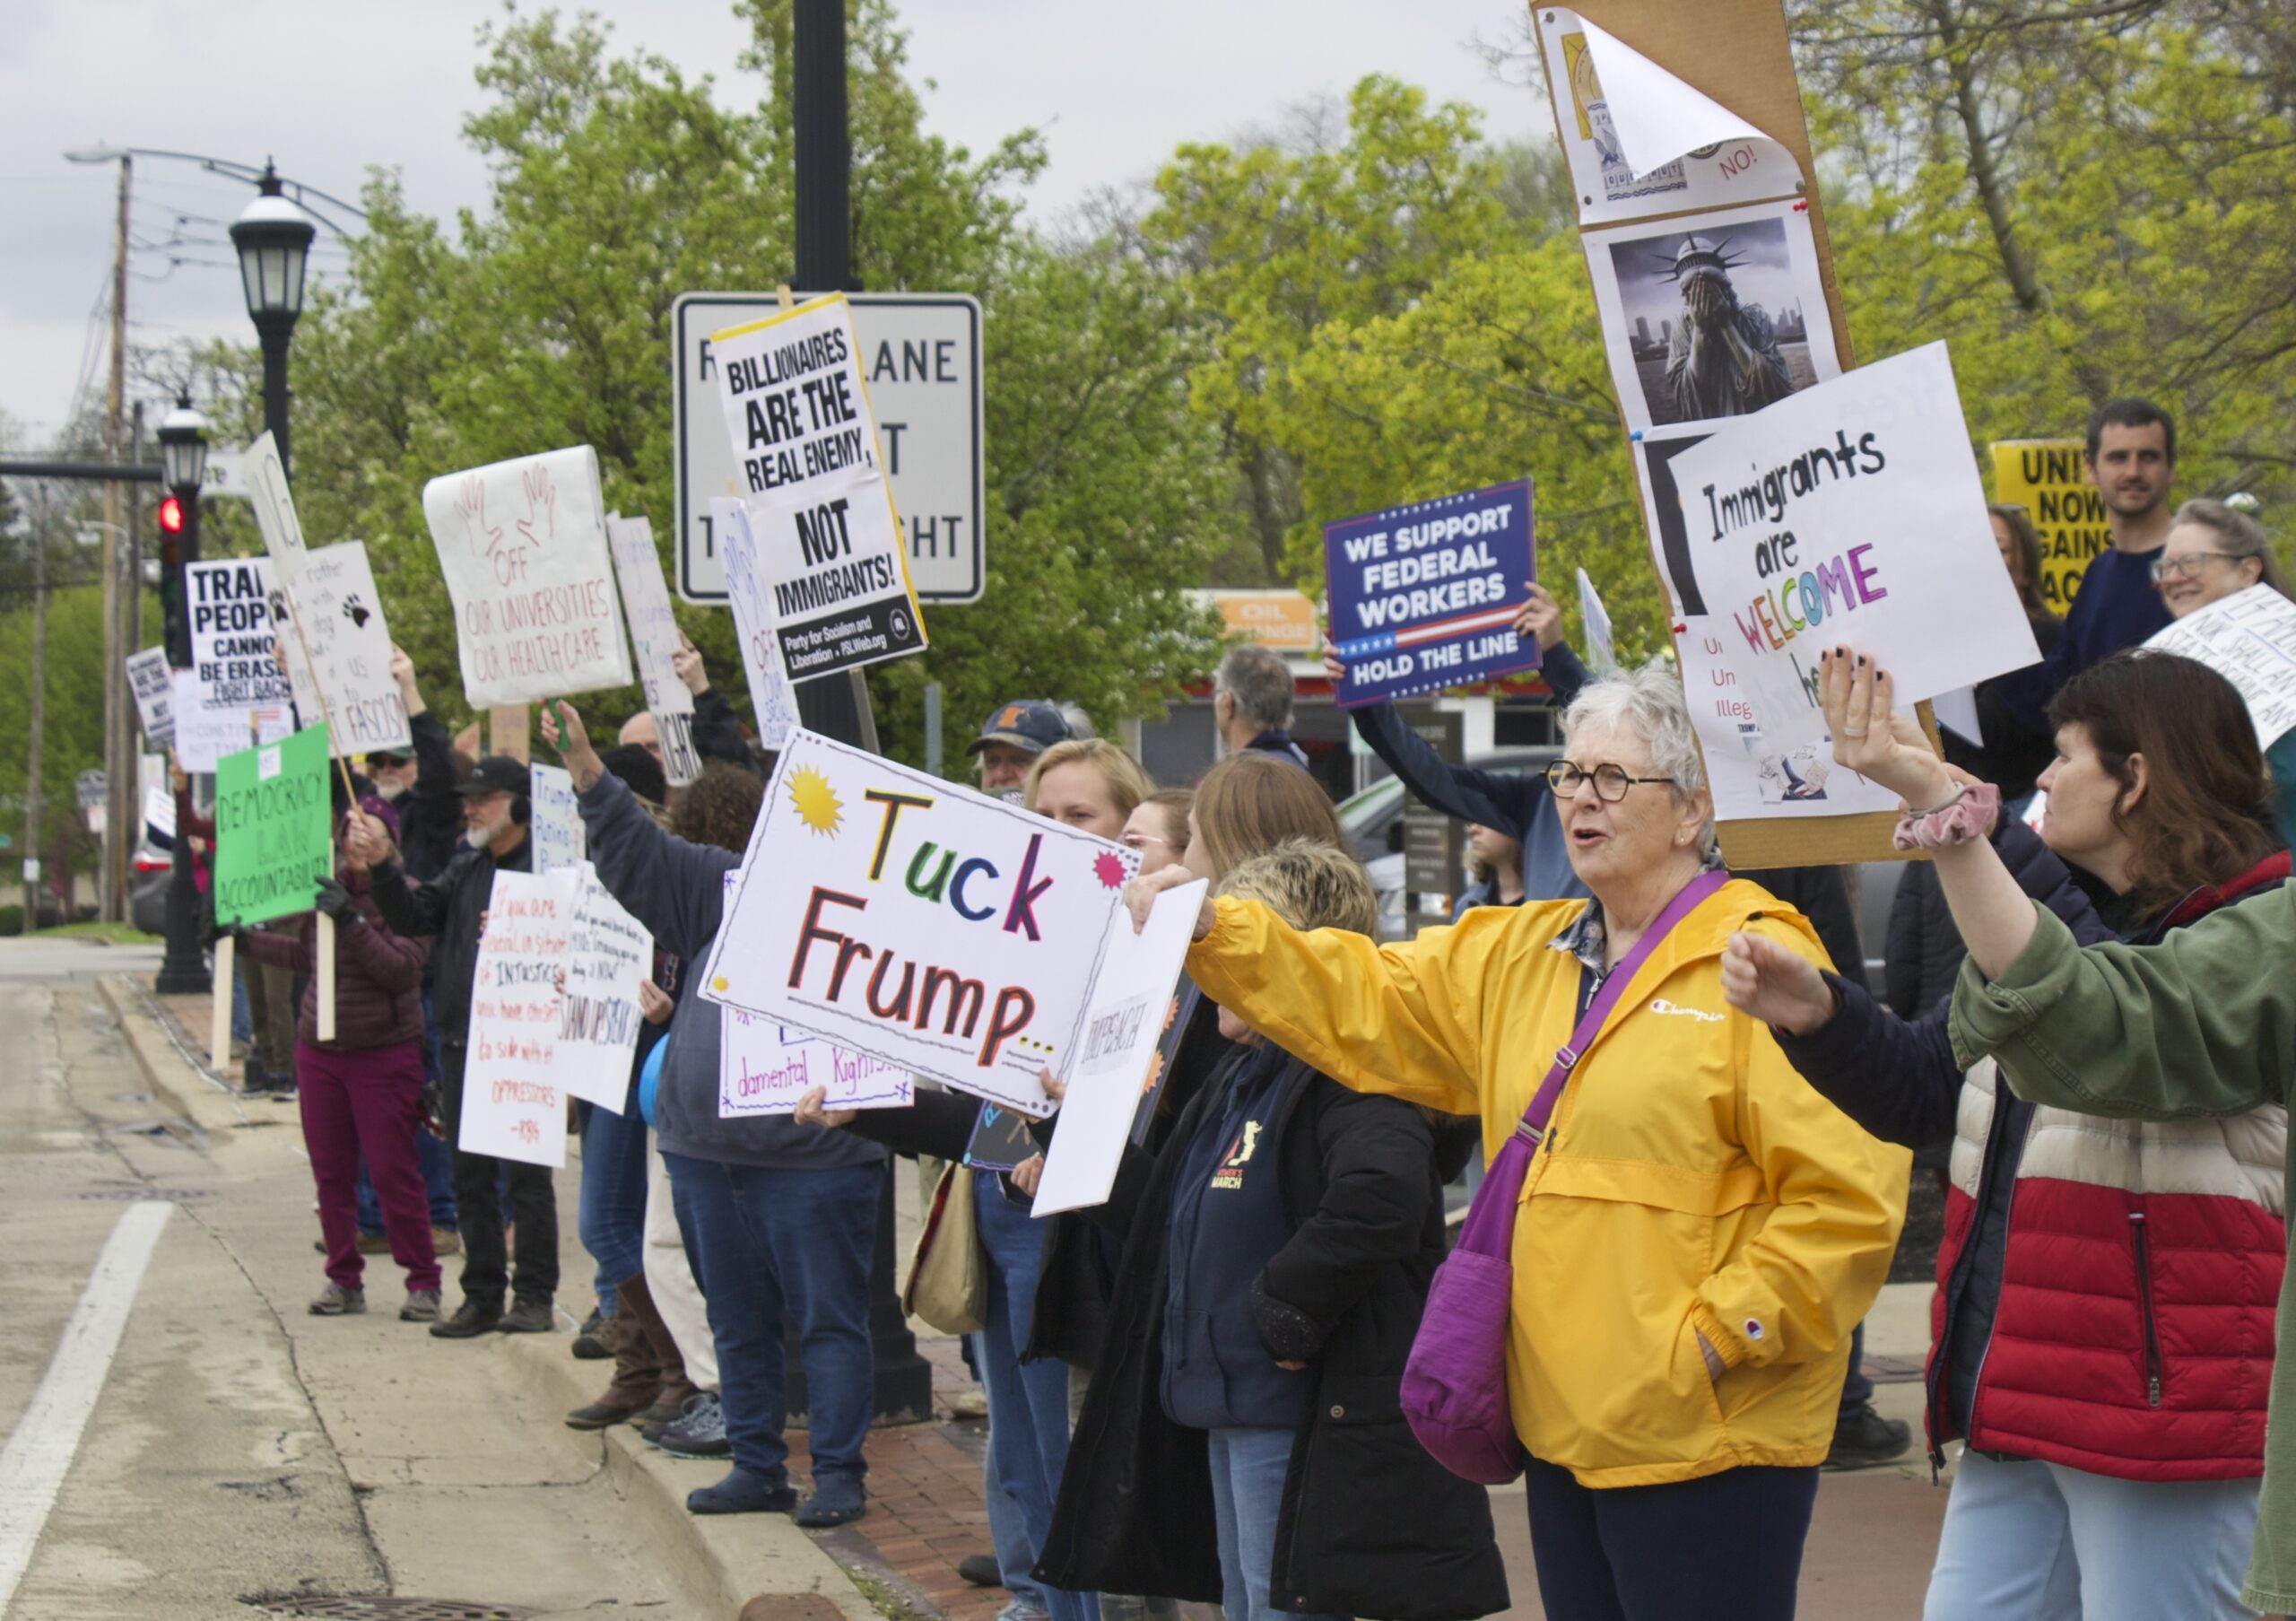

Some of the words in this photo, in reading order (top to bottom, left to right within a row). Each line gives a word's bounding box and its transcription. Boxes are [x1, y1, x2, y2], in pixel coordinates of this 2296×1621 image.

[1719, 144, 1758, 180] NO!
[726, 327, 848, 395] BILLIONAIRES
[865, 339, 958, 383] ANE
[745, 385, 804, 450] ARE
[803, 370, 857, 432] THE
[744, 452, 804, 492] REAL
[806, 426, 873, 476] ENEMY,
[2022, 449, 2087, 484] UNI
[1701, 429, 1886, 542] Immigrants
[2039, 491, 2108, 523] NOW
[795, 498, 851, 567] NOT
[1345, 533, 1388, 563] WE
[1394, 504, 1513, 554] SUPPORT
[1755, 529, 1799, 579] are
[192, 564, 265, 602] TRA
[494, 545, 528, 588] OFF
[774, 553, 896, 617] IMMIGRANTS!
[1362, 541, 1498, 595] FEDERAL
[195, 601, 274, 633] PEOP
[499, 578, 610, 632] UNIVERSITIES
[1240, 602, 1285, 622] OIL
[1356, 572, 1507, 629] WORKERS
[1734, 542, 1888, 656] WELCOME
[213, 635, 276, 658] CANNO
[785, 634, 809, 652] Party
[809, 630, 822, 645] for
[822, 621, 856, 641] Socialism
[856, 614, 873, 632] and
[789, 649, 834, 670] Liberation
[839, 633, 888, 657] PSLWeb.org
[199, 661, 223, 682] BE
[228, 658, 285, 681] ERAS
[1352, 654, 1414, 686] HOLD
[1419, 644, 1464, 674] THE
[1467, 631, 1519, 663] LINE
[1717, 700, 1752, 720] Illeg
[219, 769, 323, 835] DEMOCRACY
[864, 788, 1054, 943] Tuck
[738, 1050, 808, 1098] damental
[1211, 1176, 1243, 1190] MARCH
